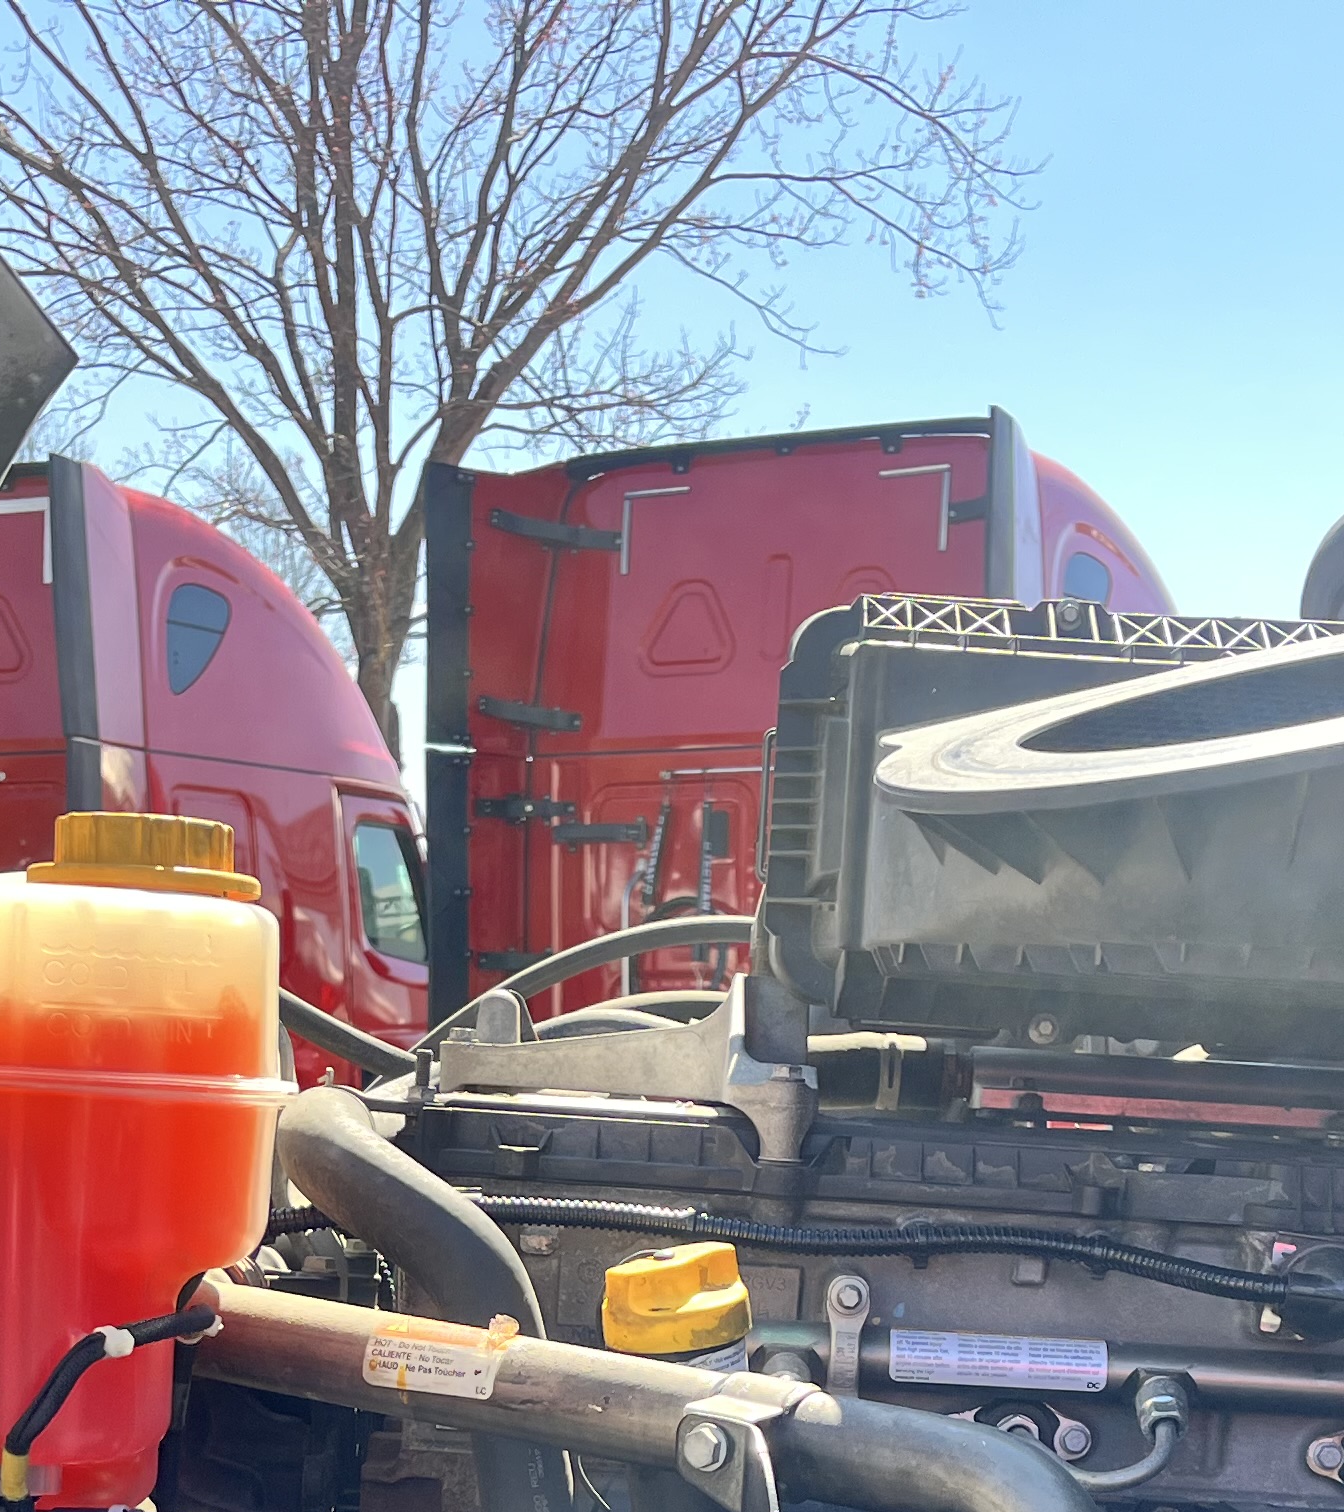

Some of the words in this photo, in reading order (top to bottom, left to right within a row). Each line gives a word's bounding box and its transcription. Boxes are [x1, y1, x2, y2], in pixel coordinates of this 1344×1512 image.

[374, 1338, 391, 1348] HOT
[371, 1348, 412, 1361] CALIENTE
[419, 1354, 431, 1363] No
[405, 1363, 416, 1373] Ne
[417, 1366, 432, 1375] Pas
[1086, 1381, 1101, 1390] DC
